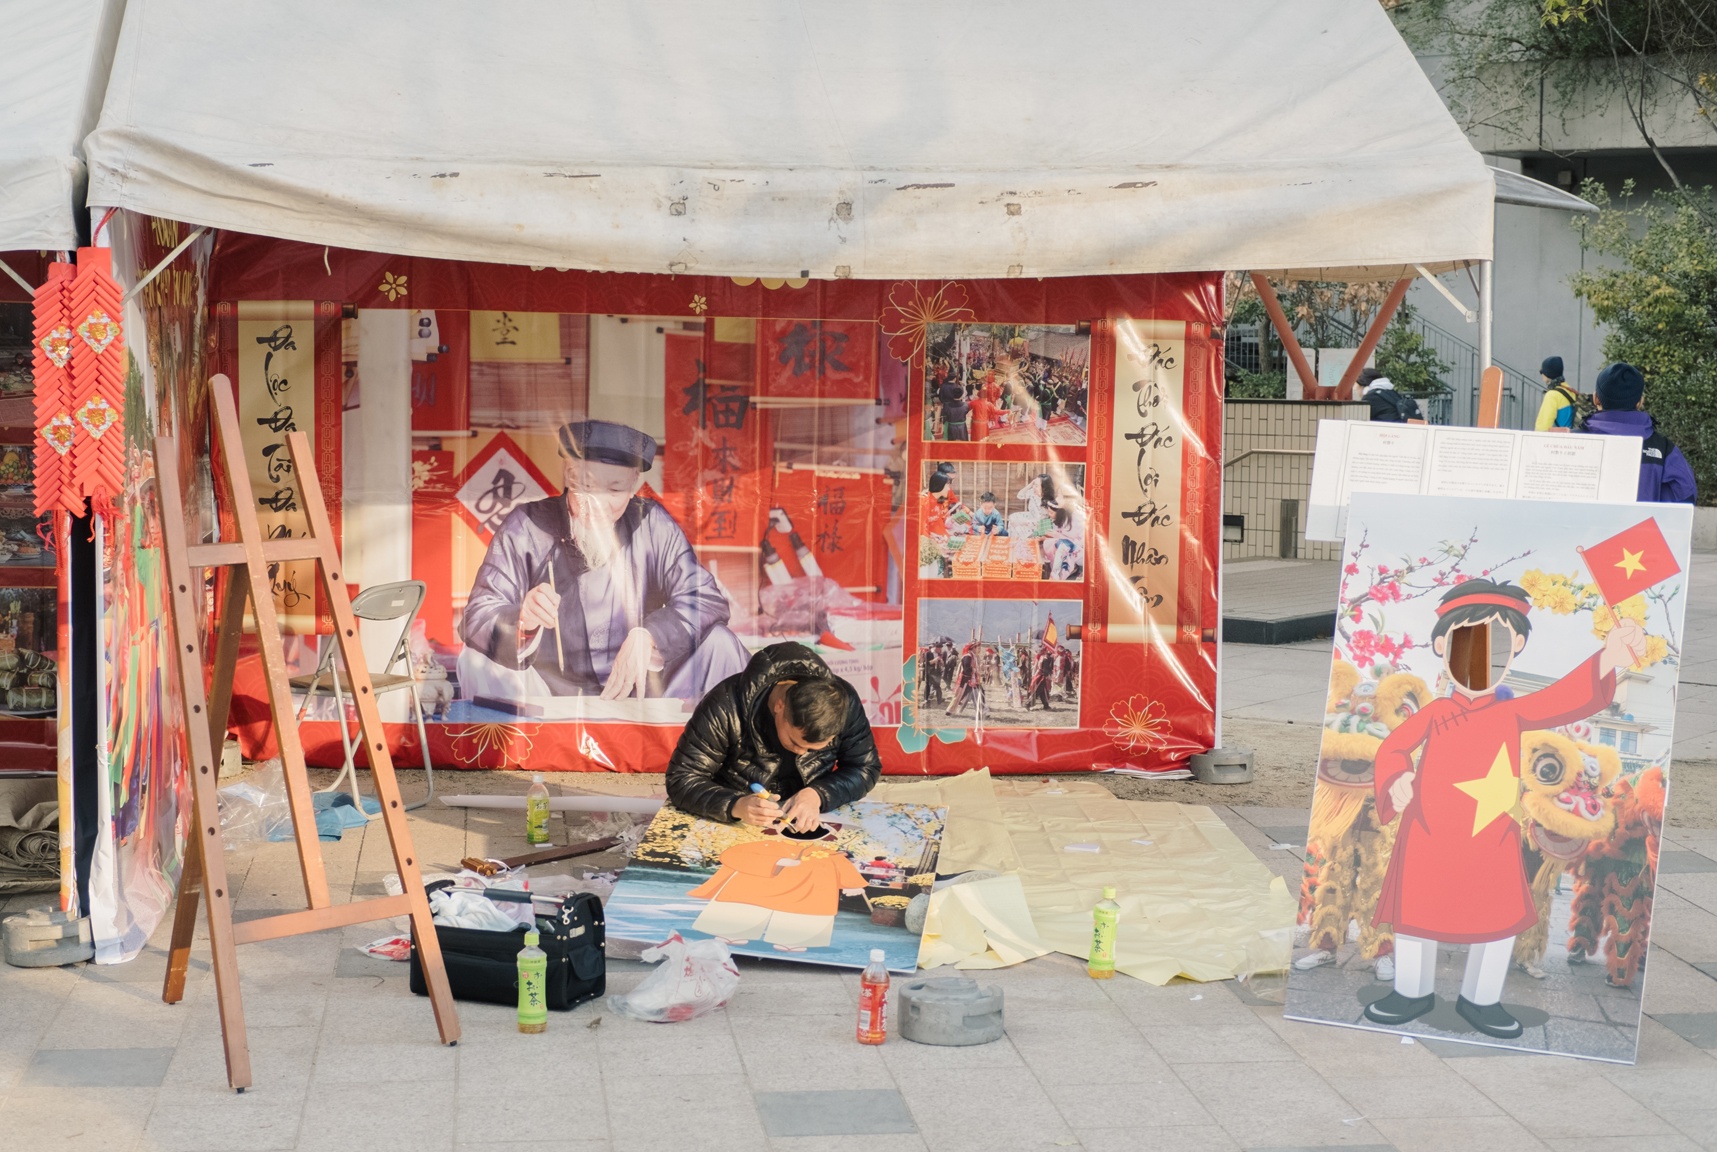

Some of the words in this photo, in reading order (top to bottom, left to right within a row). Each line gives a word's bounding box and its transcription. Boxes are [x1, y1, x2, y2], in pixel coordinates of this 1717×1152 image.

[256, 324, 297, 352] Đa
[264, 351, 292, 407] Lộc
[256, 405, 298, 433] Đa
[258, 486, 298, 513] Đa
[1121, 534, 1169, 571] Nhân
